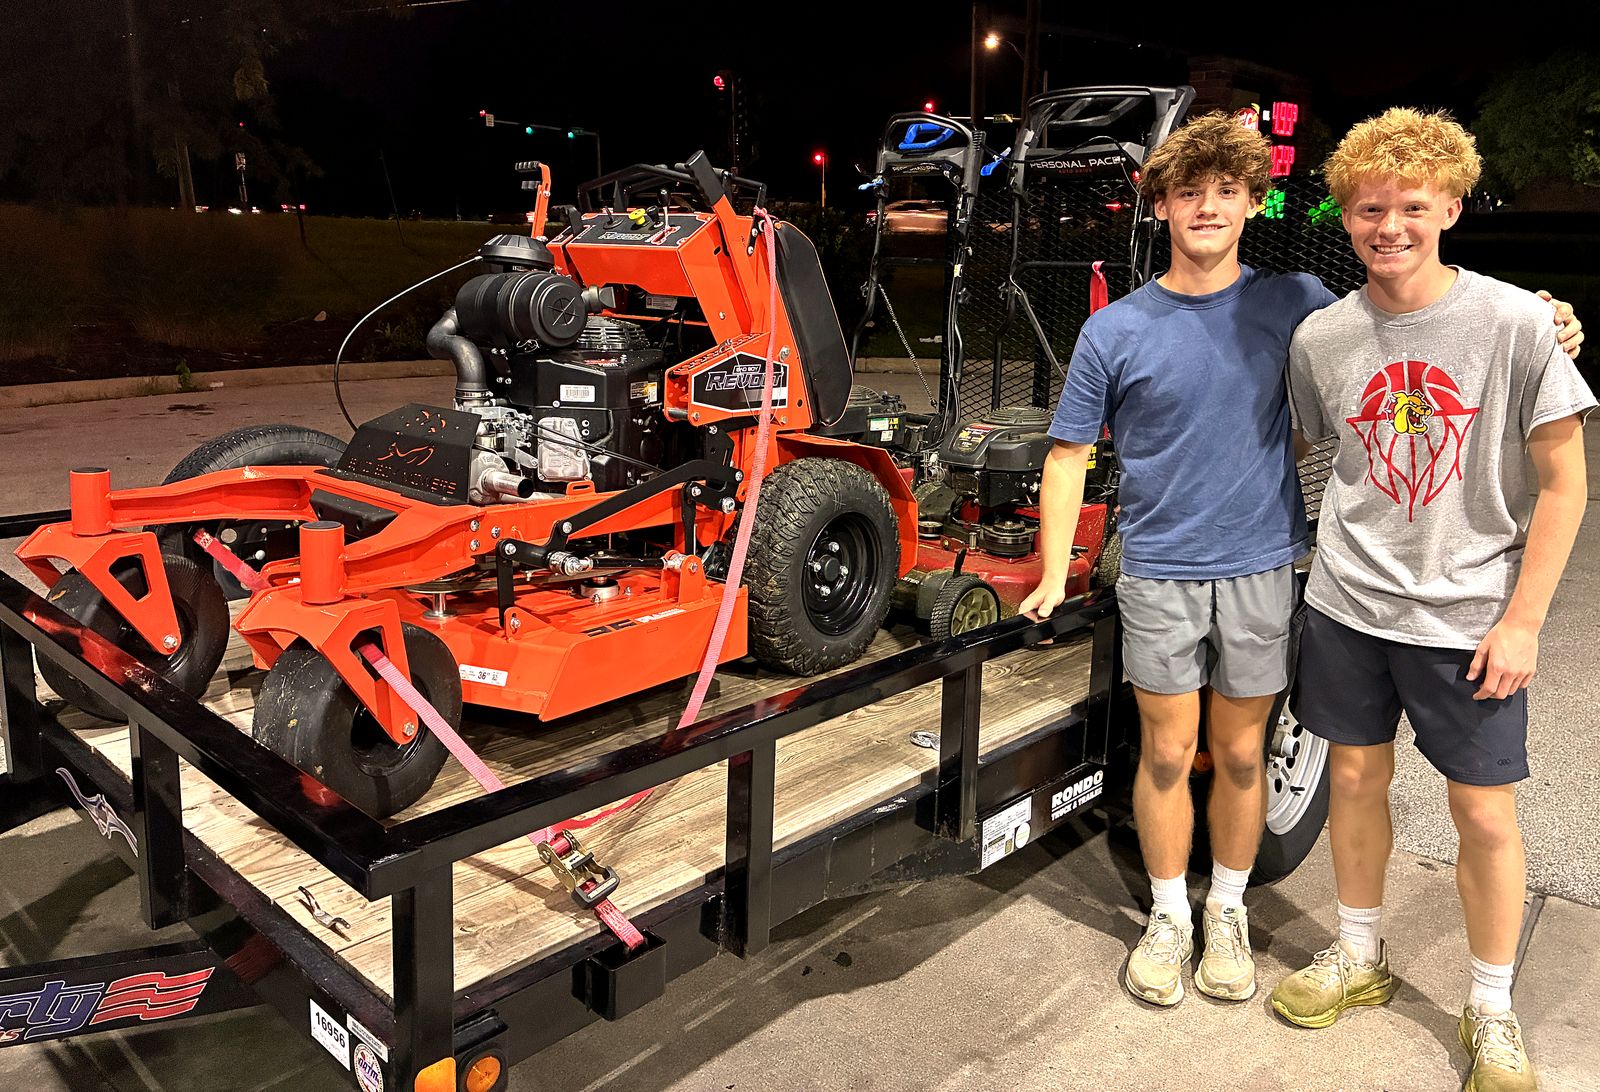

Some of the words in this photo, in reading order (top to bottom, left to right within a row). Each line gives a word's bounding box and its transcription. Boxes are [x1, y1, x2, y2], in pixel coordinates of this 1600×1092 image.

[705, 371, 783, 391] REVOT
[1052, 770, 1104, 809] RONDO
[315, 1011, 346, 1048] 16956
